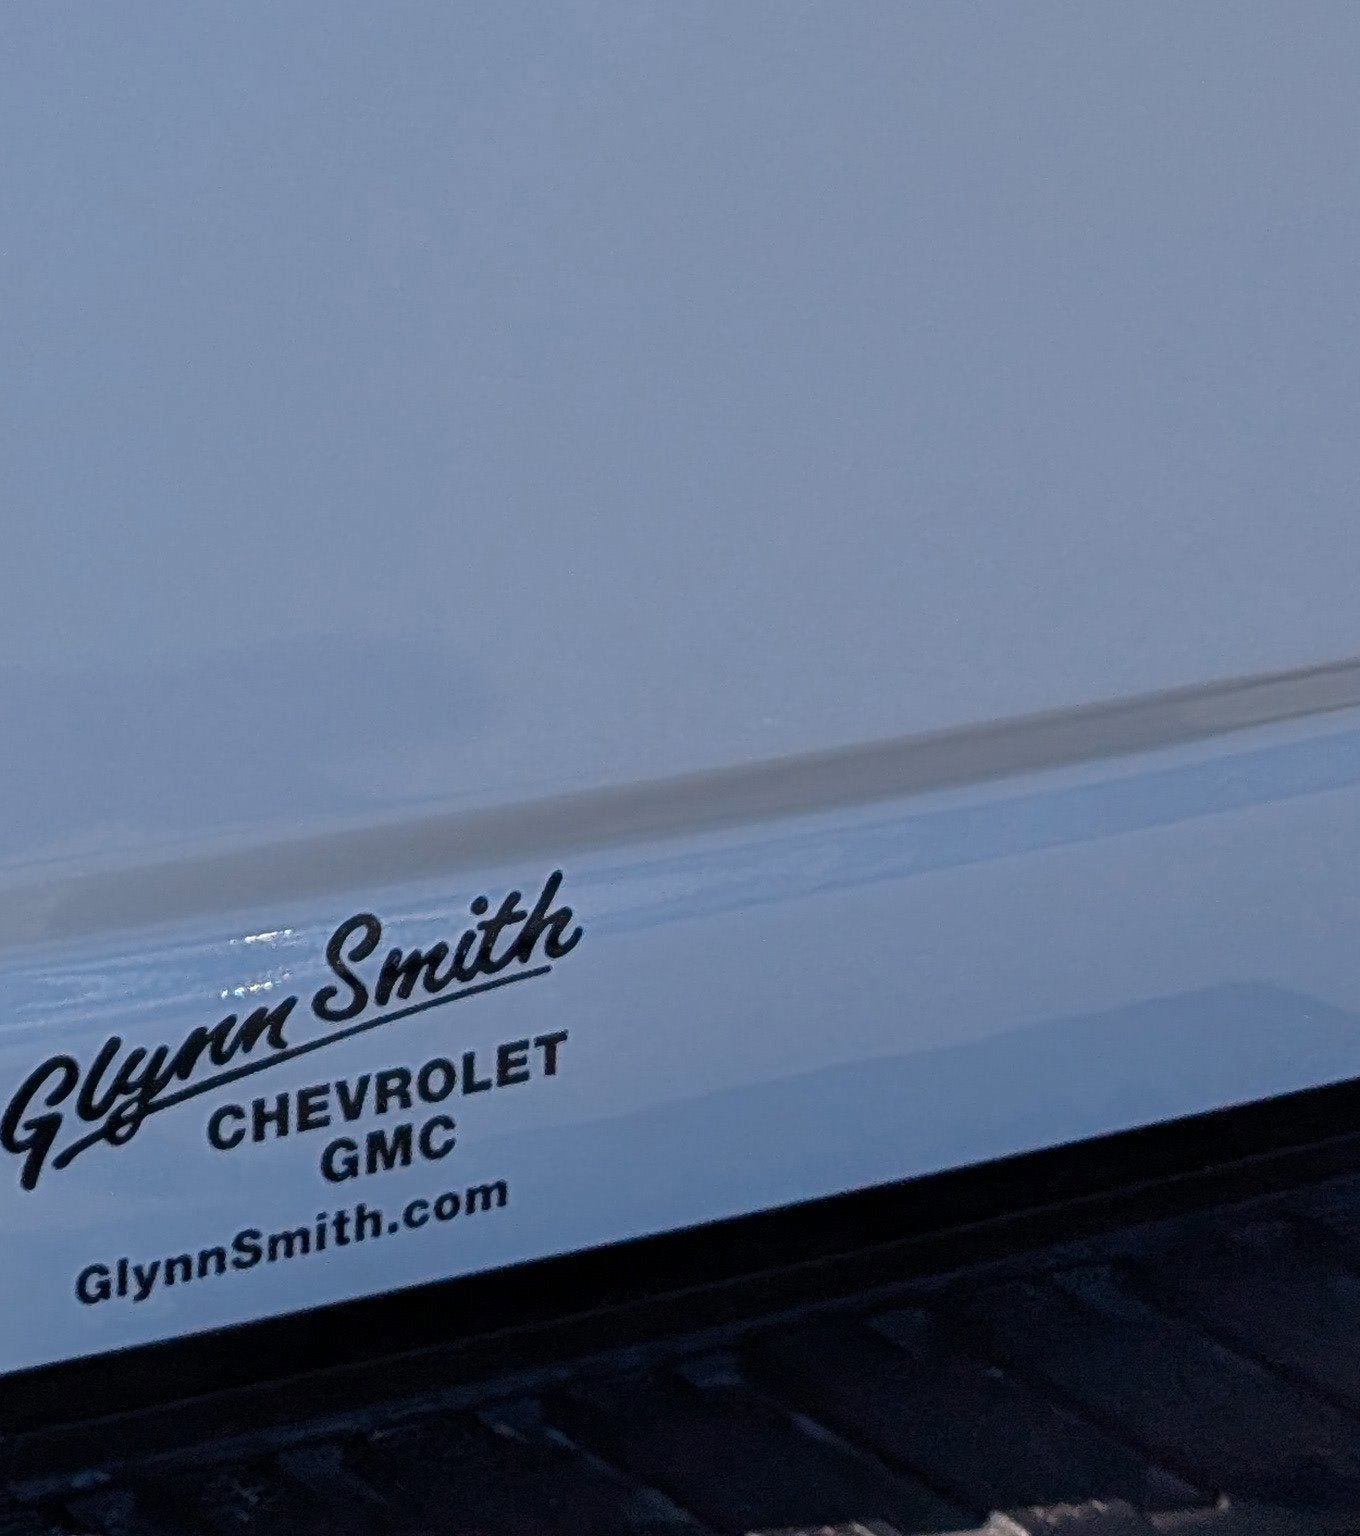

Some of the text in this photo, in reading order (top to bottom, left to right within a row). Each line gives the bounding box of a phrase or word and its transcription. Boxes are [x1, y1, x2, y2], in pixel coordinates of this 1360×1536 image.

[311, 869, 584, 1023] Smith
[206, 1029, 569, 1152] CHEVROLET
[320, 1114, 458, 1184] GMC
[74, 1179, 509, 1307] GlynnSmith.com
